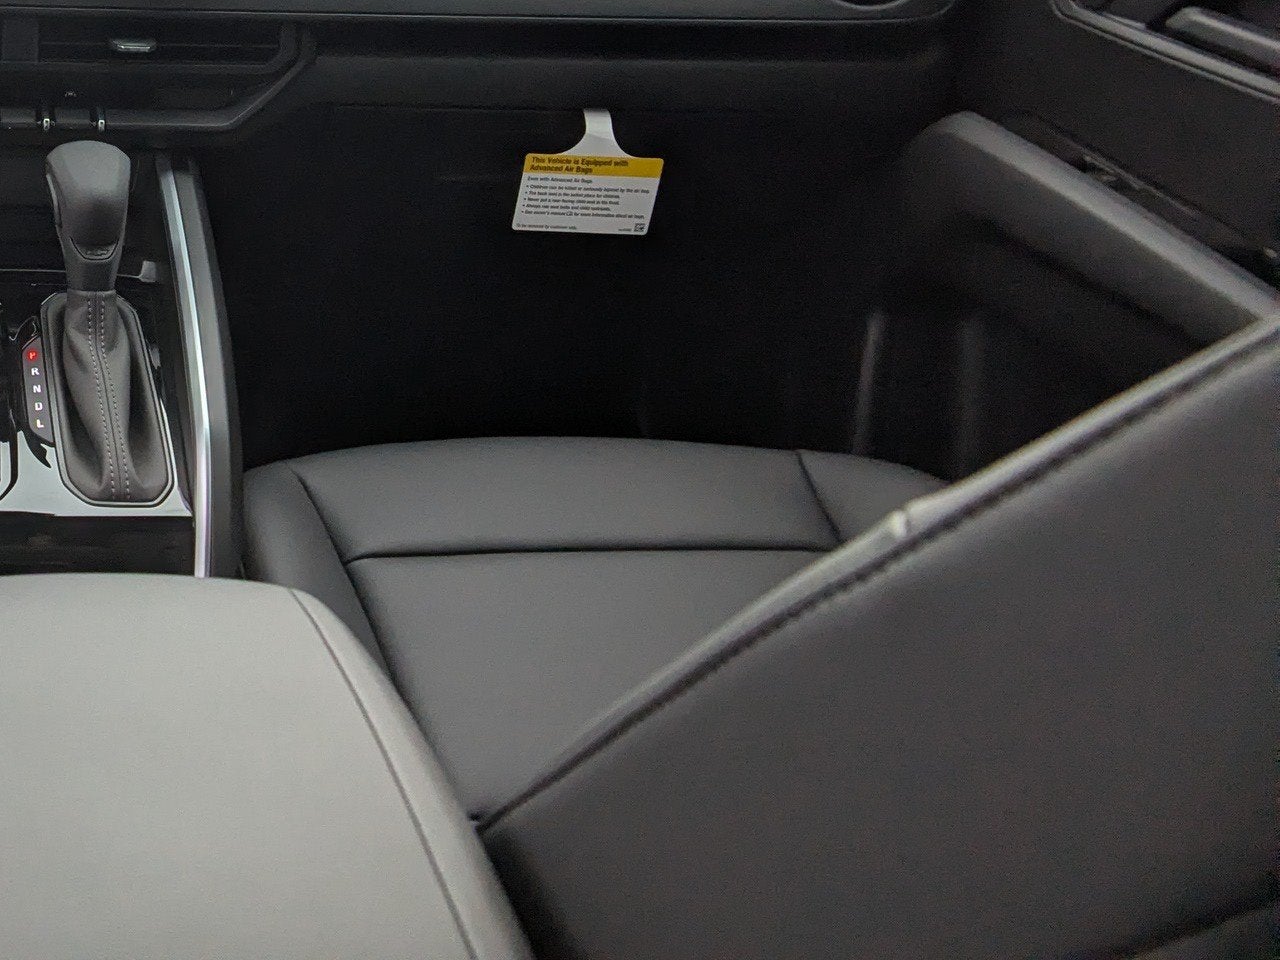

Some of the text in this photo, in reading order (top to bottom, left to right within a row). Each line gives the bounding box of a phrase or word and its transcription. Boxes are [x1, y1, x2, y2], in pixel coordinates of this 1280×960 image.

[532, 156, 545, 164] This
[548, 157, 572, 165] Vehicle
[581, 158, 612, 167] Equipped
[576, 166, 593, 174] Bags
[31, 367, 40, 376] R
[33, 384, 42, 393] N
[34, 402, 43, 411] D
[36, 419, 45, 428] L
